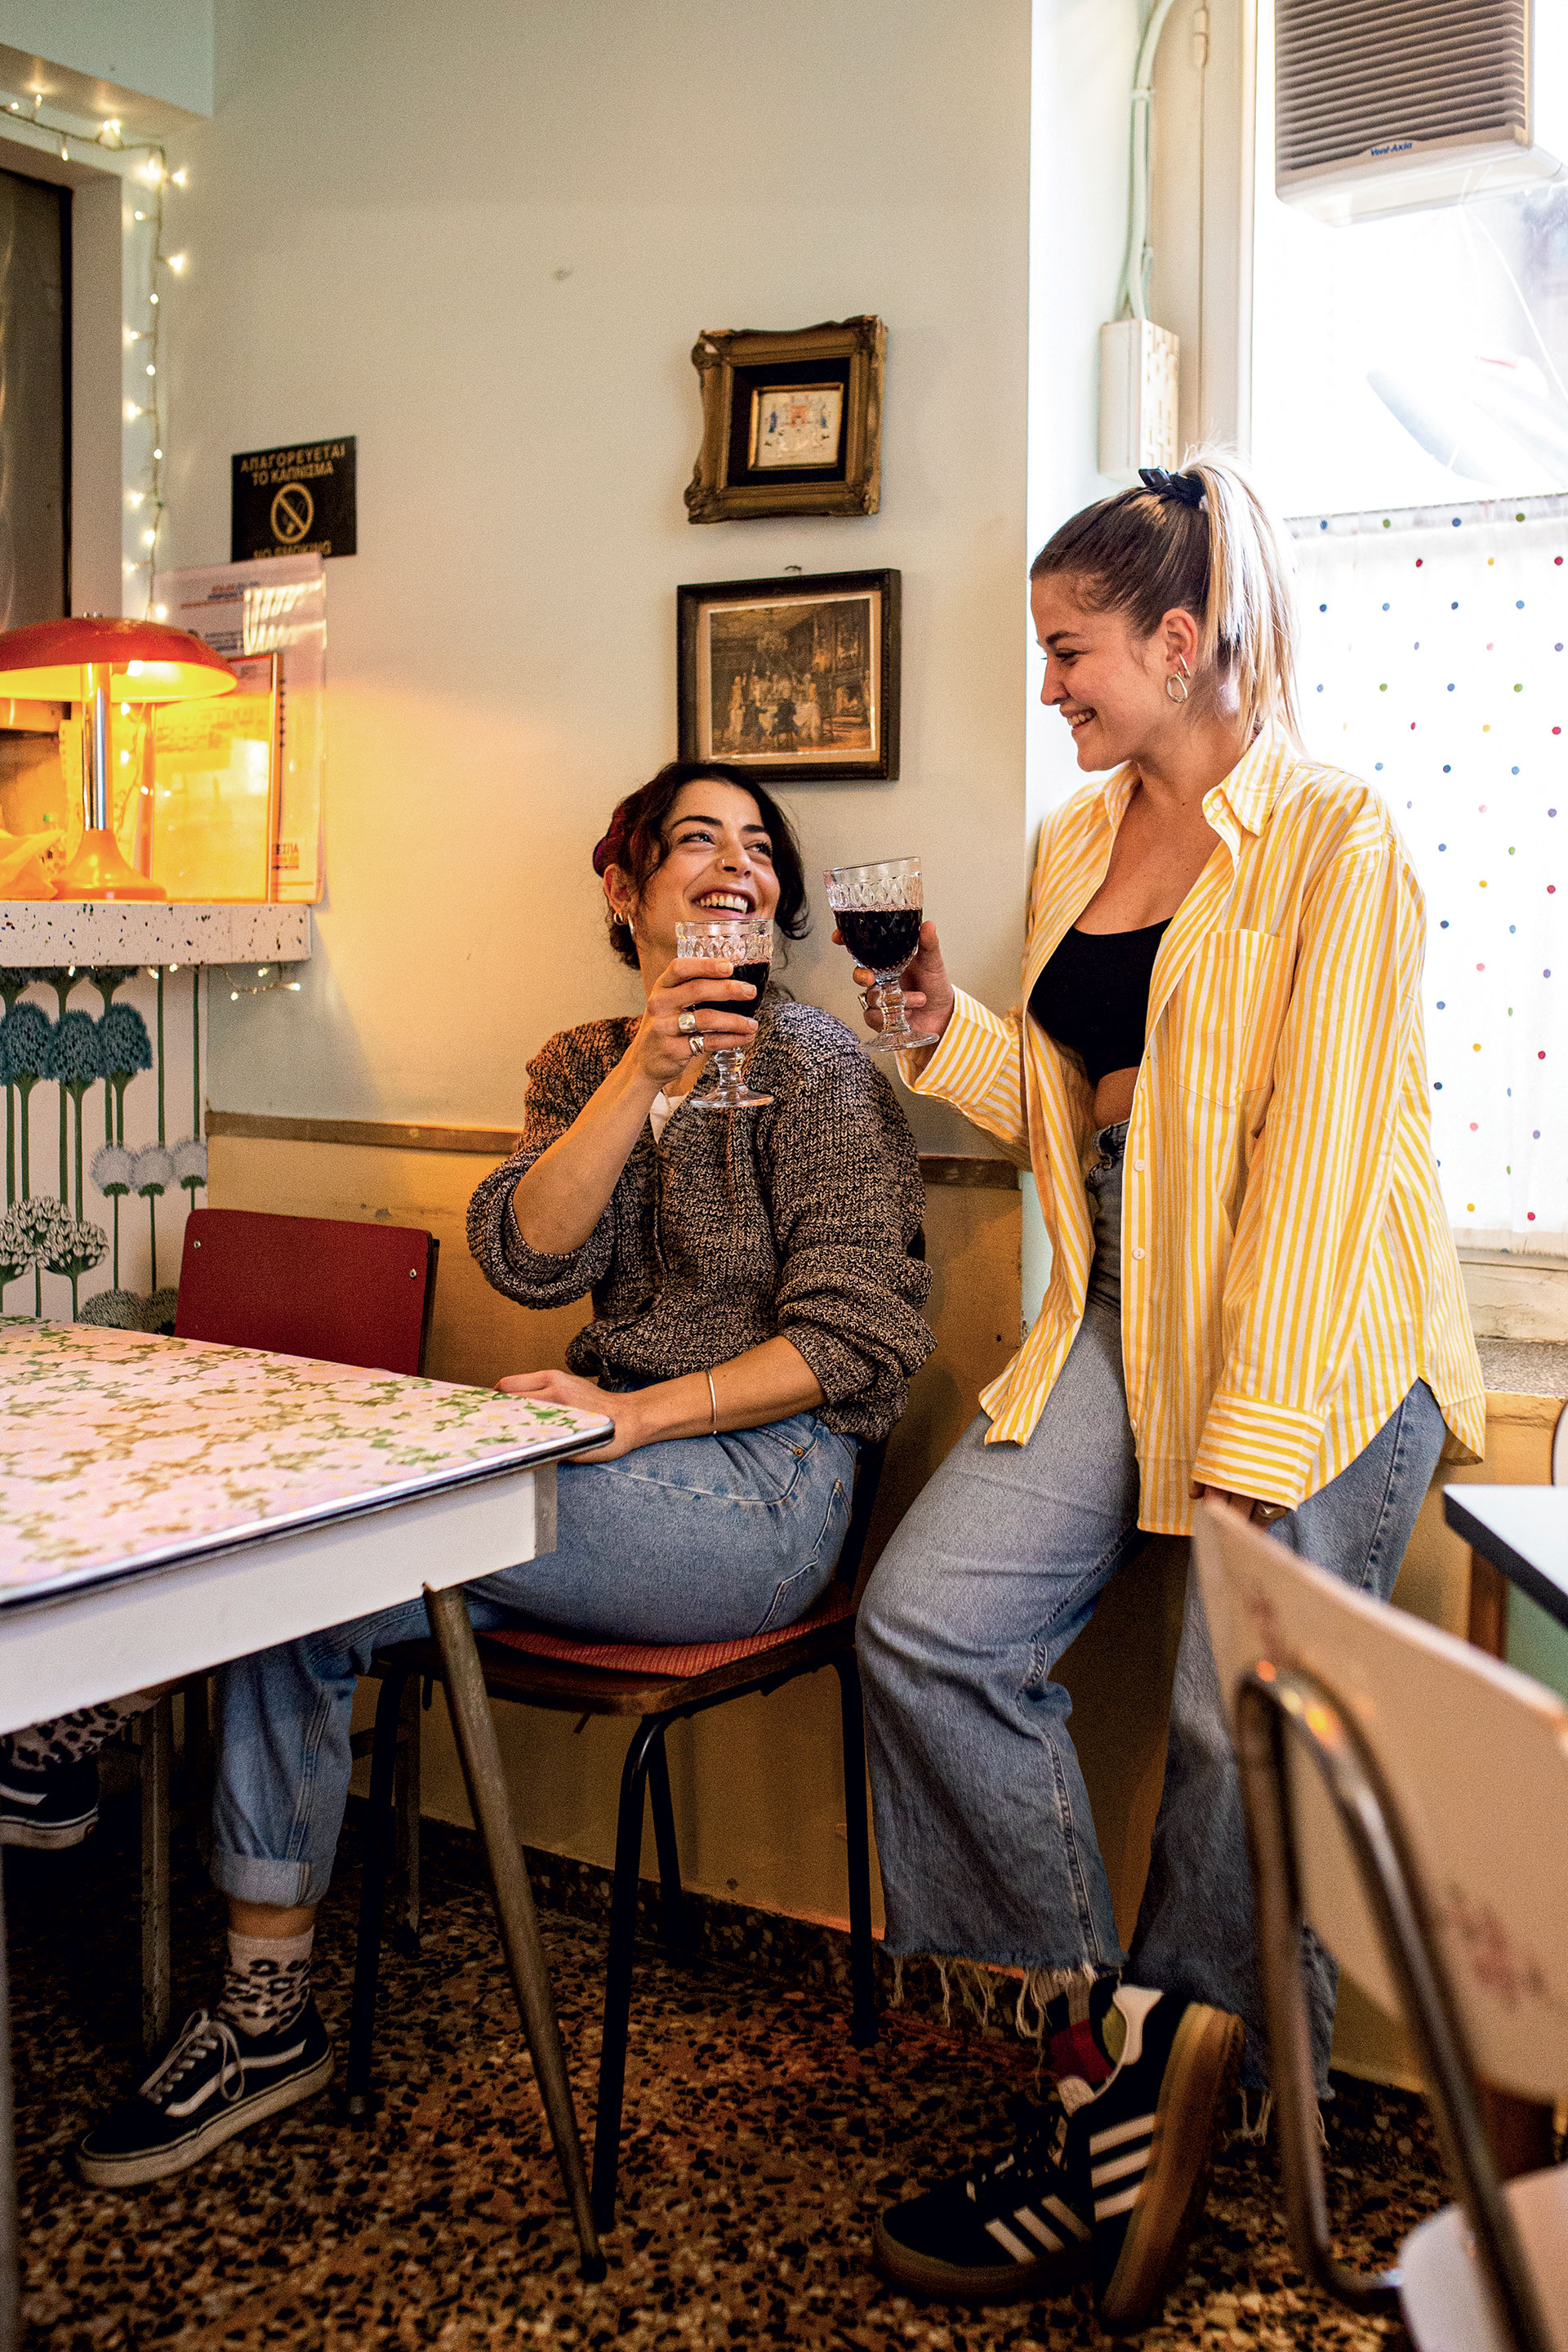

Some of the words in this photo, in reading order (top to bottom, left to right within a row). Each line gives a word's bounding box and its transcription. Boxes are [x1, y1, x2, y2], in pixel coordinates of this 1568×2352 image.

[1370, 142, 1413, 156] Vent-Axia
[240, 444, 345, 473] ΑΠΑΓΟΡΕΥΕΤΑΙ
[252, 470, 270, 486] ΤΟ
[271, 460, 334, 483] ΚΑΠΝΙΣΜΑ
